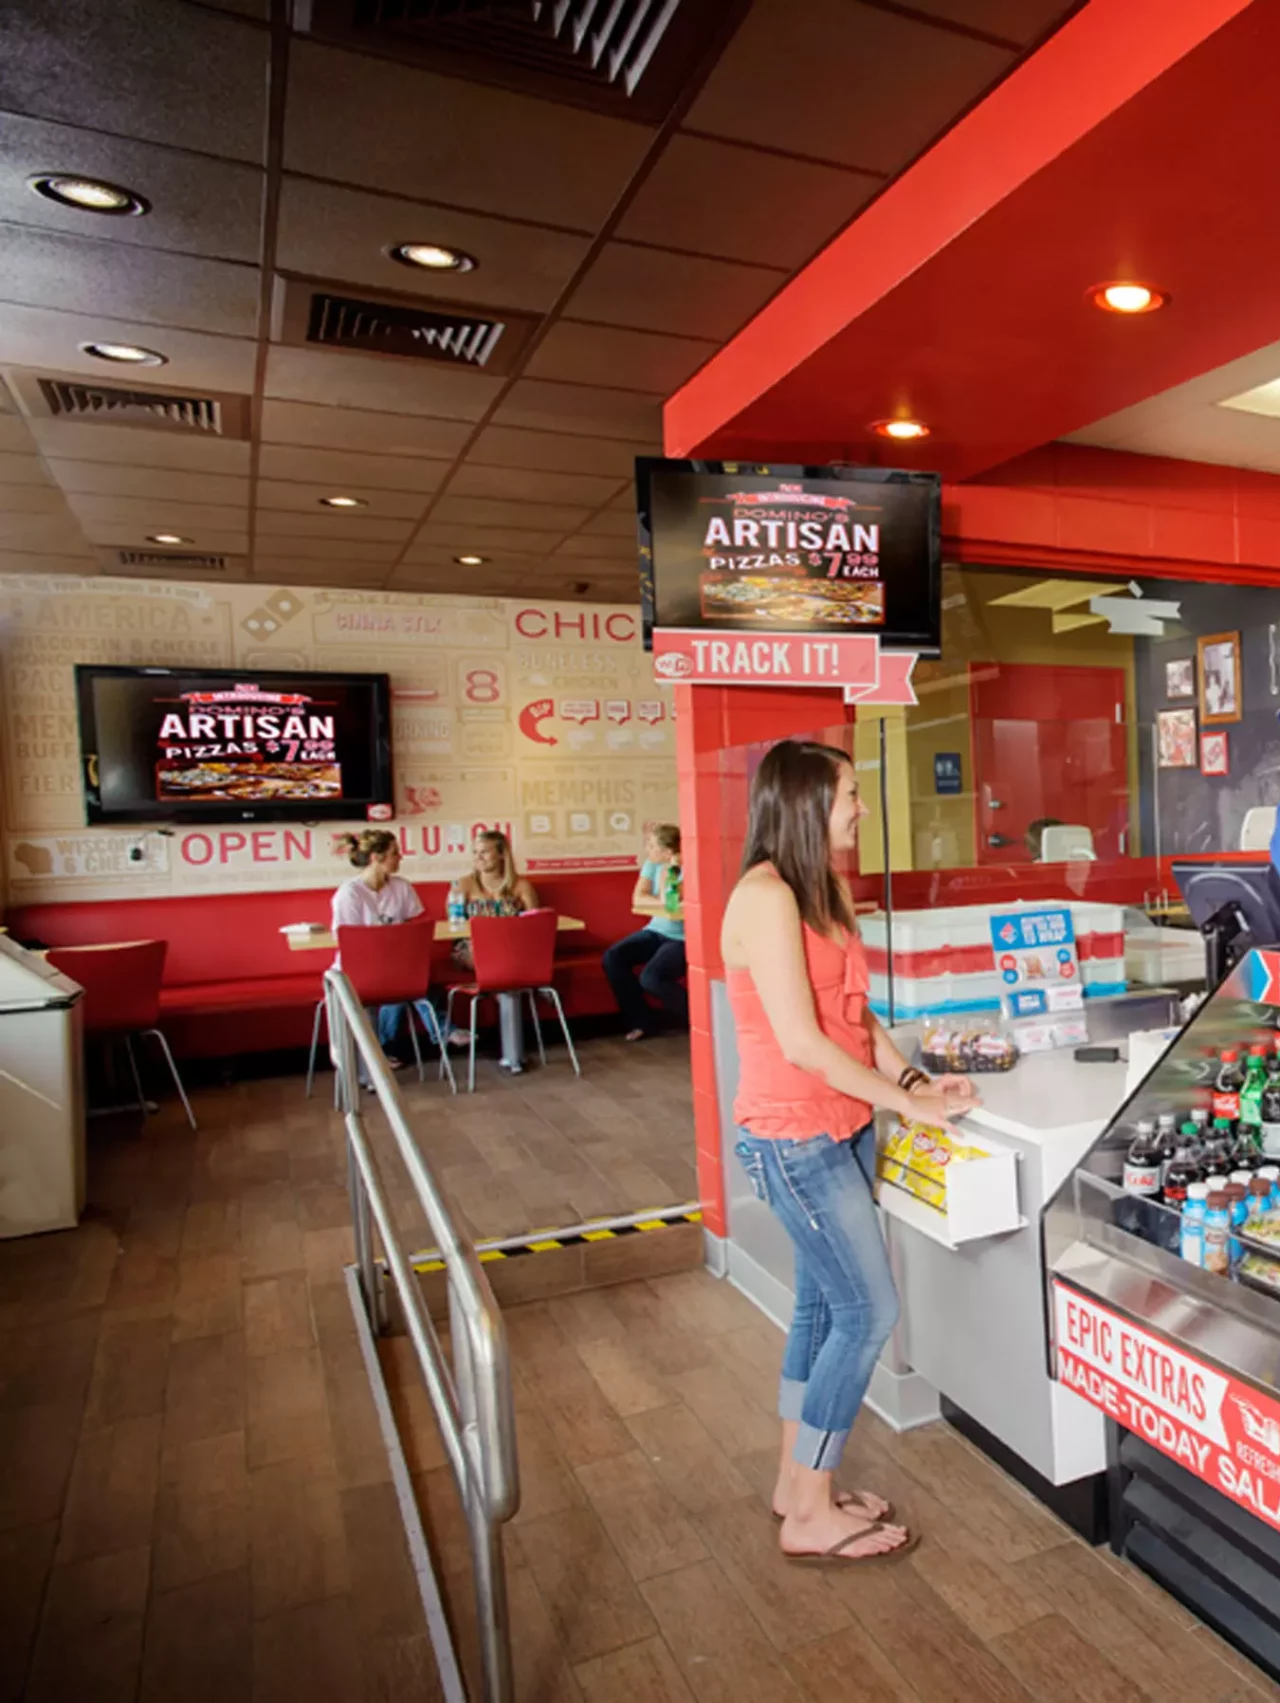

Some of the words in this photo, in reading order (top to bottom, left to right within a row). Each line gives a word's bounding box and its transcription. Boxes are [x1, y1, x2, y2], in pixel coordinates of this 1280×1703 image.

[733, 508, 850, 523] DOMINO'S
[704, 516, 880, 552] ARTISAN
[709, 552, 801, 570] PIZZAS
[842, 567, 879, 578] EACH
[36, 600, 192, 633] AMERICA
[515, 609, 636, 641] CHIC
[10, 635, 121, 652] WISCONSIN
[150, 639, 221, 655] CHEESE
[691, 640, 791, 675] TRACK
[803, 643, 839, 675] IT!
[11, 669, 64, 692] PAC
[466, 670, 500, 702] 8
[188, 705, 306, 715] DOMINO'S
[159, 714, 335, 739] ARTISAN
[17, 742, 77, 759] BUFF
[166, 741, 259, 759] PIZZAS
[301, 751, 336, 761] EACH
[20, 776, 75, 792] FIER
[522, 779, 634, 806] MEMPHIS
[181, 830, 313, 866] OPEN
[1067, 1300, 1113, 1365] EPIC
[1121, 1331, 1207, 1422] EXTRAS
[1057, 1351, 1212, 1474] MADE-TODAY
